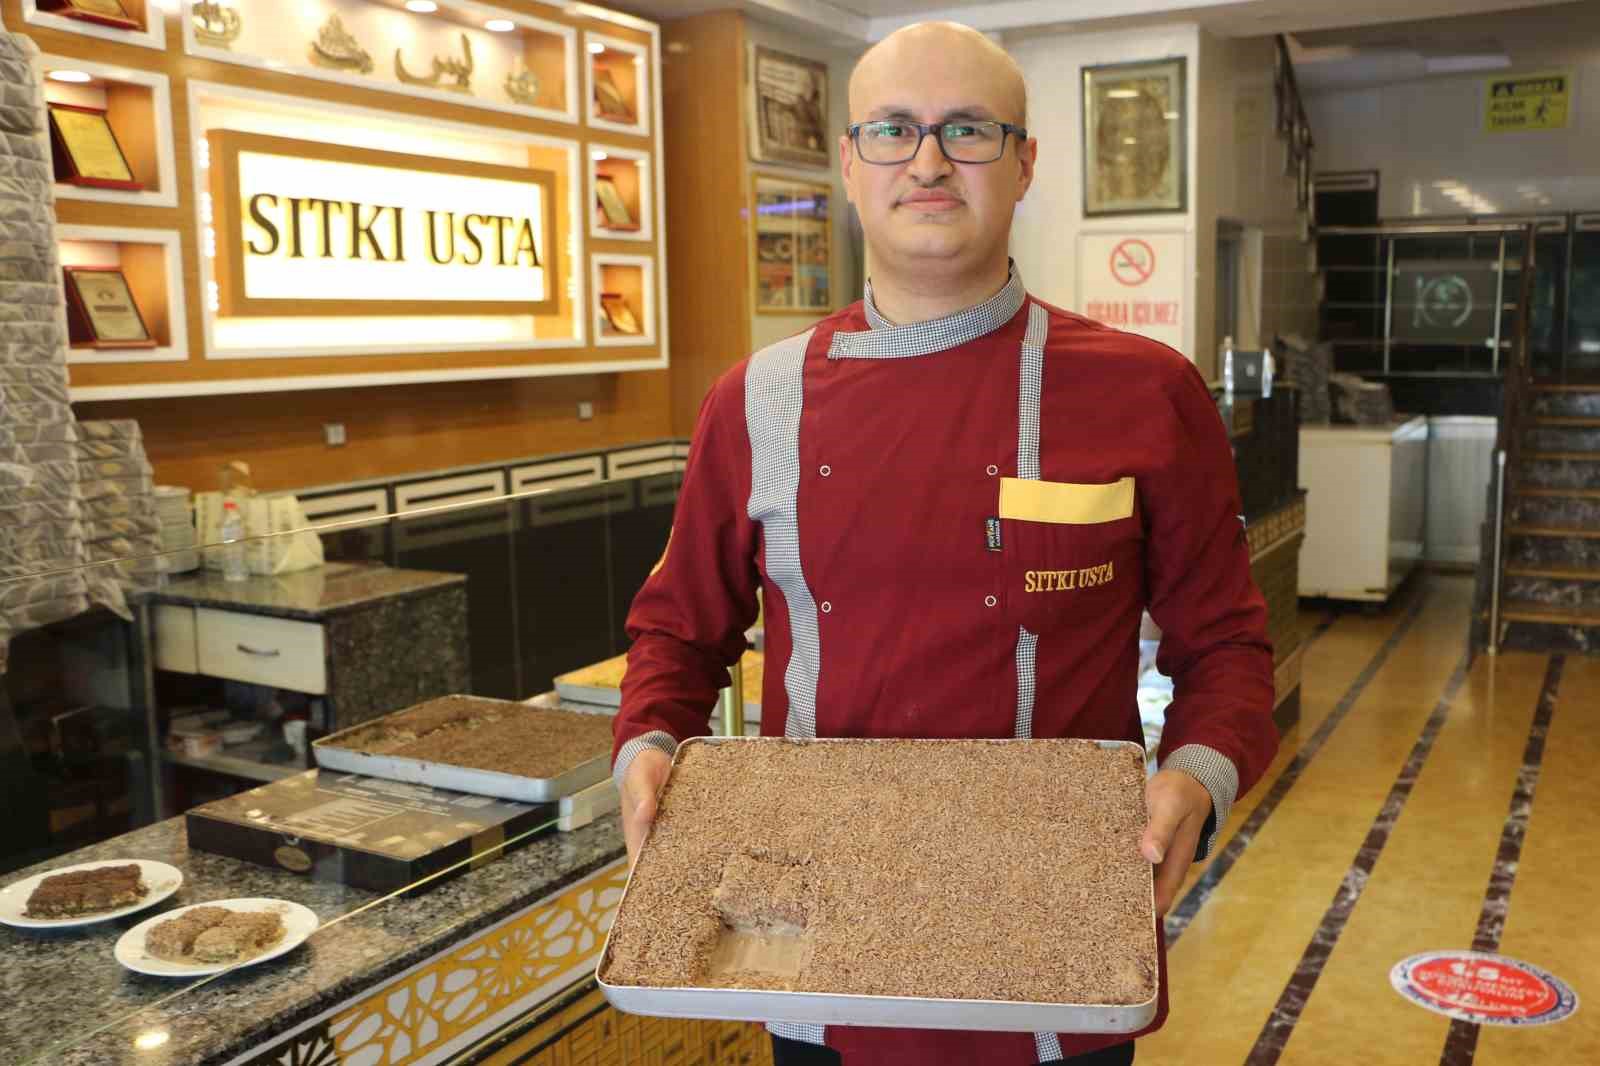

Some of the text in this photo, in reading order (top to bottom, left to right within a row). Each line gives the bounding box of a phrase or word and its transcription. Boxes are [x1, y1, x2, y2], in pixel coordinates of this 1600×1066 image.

[247, 192, 543, 267] SITKI USTA
[1024, 560, 1114, 592] SITKI USTA
